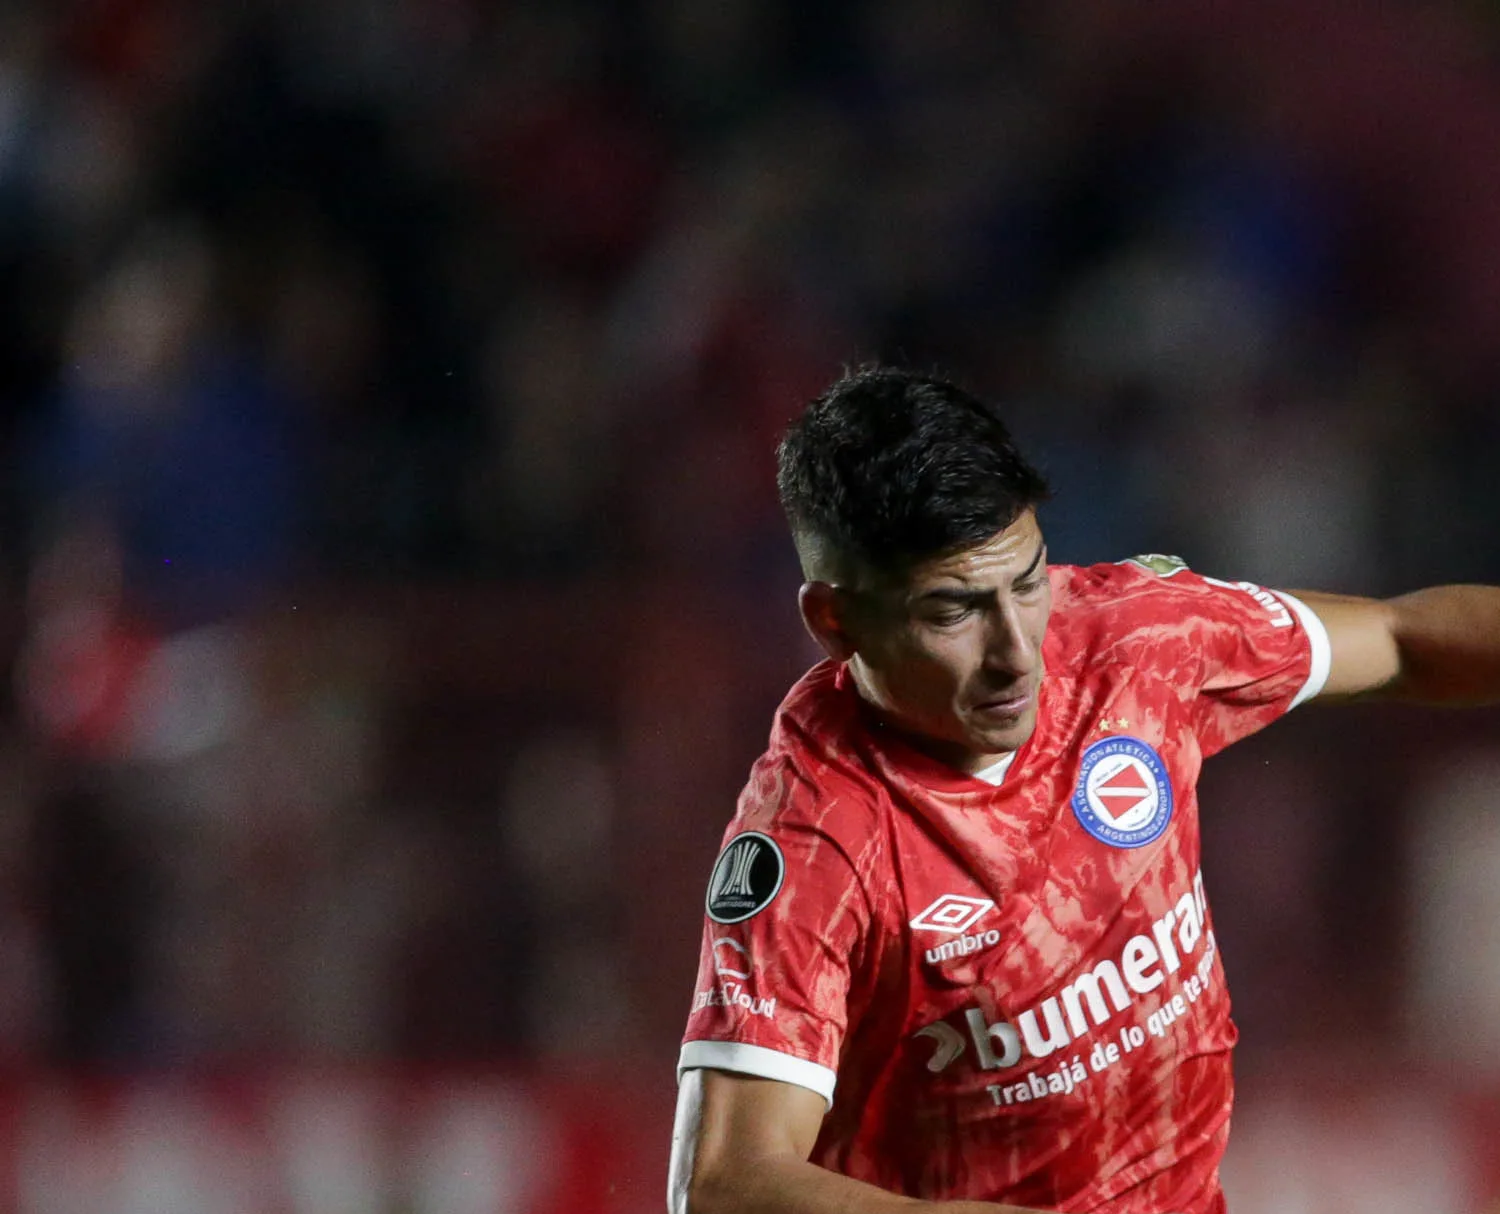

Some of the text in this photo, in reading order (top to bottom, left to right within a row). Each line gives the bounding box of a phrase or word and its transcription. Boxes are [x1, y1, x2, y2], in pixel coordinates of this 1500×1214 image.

[925, 929, 1000, 964] umbro
[986, 974, 1202, 1107] Trabajá de lo que te
